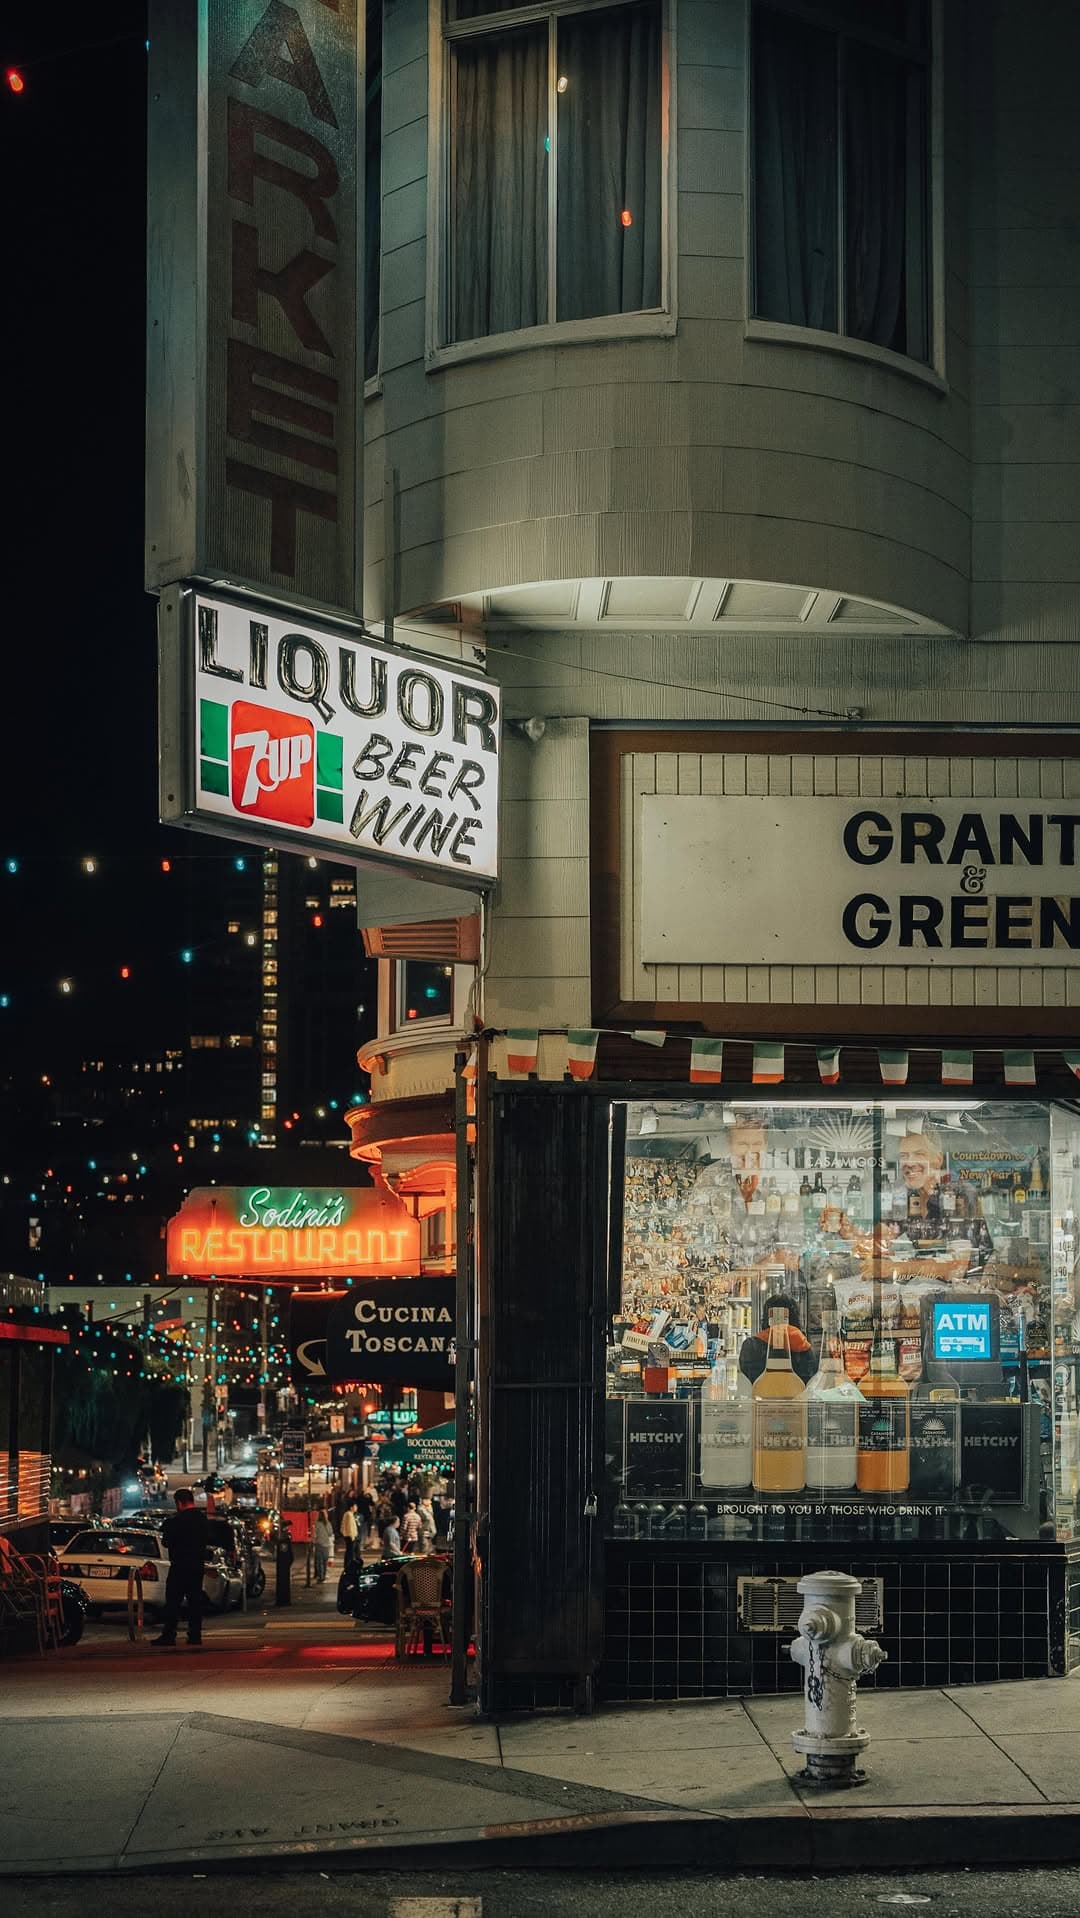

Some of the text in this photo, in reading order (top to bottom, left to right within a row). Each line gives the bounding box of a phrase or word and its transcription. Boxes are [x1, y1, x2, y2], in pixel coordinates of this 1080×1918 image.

[226, 0, 339, 578] ARKET
[198, 604, 498, 754] LIQUOR
[352, 732, 485, 812] BEER
[350, 788, 483, 865] WINE
[843, 810, 1080, 866] GRANT
[959, 865, 987, 894] &
[842, 892, 1080, 949] GREEN
[807, 1156, 887, 1169] CASAMIGOS
[951, 1151, 1011, 1161] Countdown
[959, 1168, 984, 1180] New
[239, 1187, 345, 1228] Sodini's
[180, 1227, 409, 1263] RESTAURANT
[936, 1313, 988, 1331] ATM
[407, 1438, 456, 1448] BOCCONCIN
[629, 1432, 684, 1443] HETCHY
[964, 1436, 1019, 1447] HETCHY
[717, 1504, 769, 1516] BROUGHT
[770, 1504, 786, 1516] TO
[788, 1504, 812, 1516] YOU
[815, 1504, 828, 1516] BY
[830, 1504, 865, 1516] THOSE
[867, 1504, 896, 1516] WHO
[899, 1504, 932, 1516] DRINK
